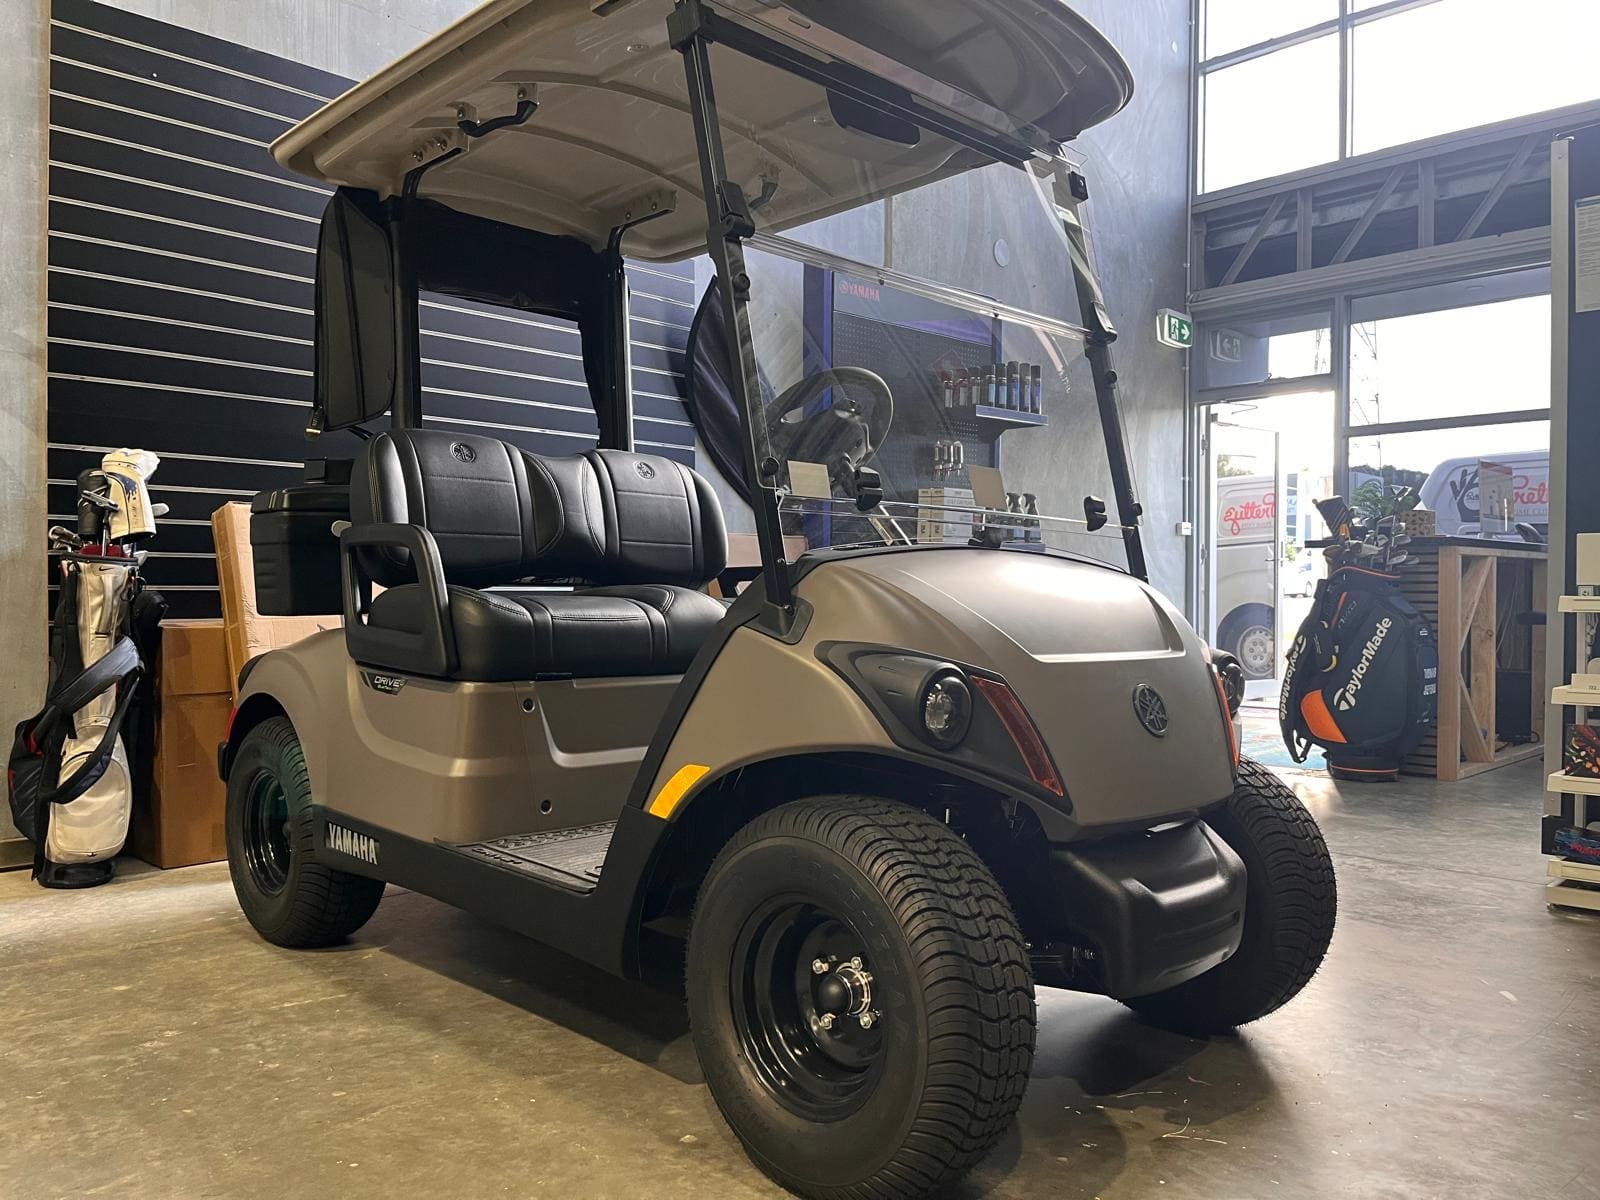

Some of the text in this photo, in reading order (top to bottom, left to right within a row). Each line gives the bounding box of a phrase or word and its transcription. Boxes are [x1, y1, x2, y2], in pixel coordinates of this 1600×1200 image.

[849, 283, 880, 302] YAMAHA
[1333, 617, 1393, 711] TaylorMade
[328, 822, 378, 865] YAMAHA
